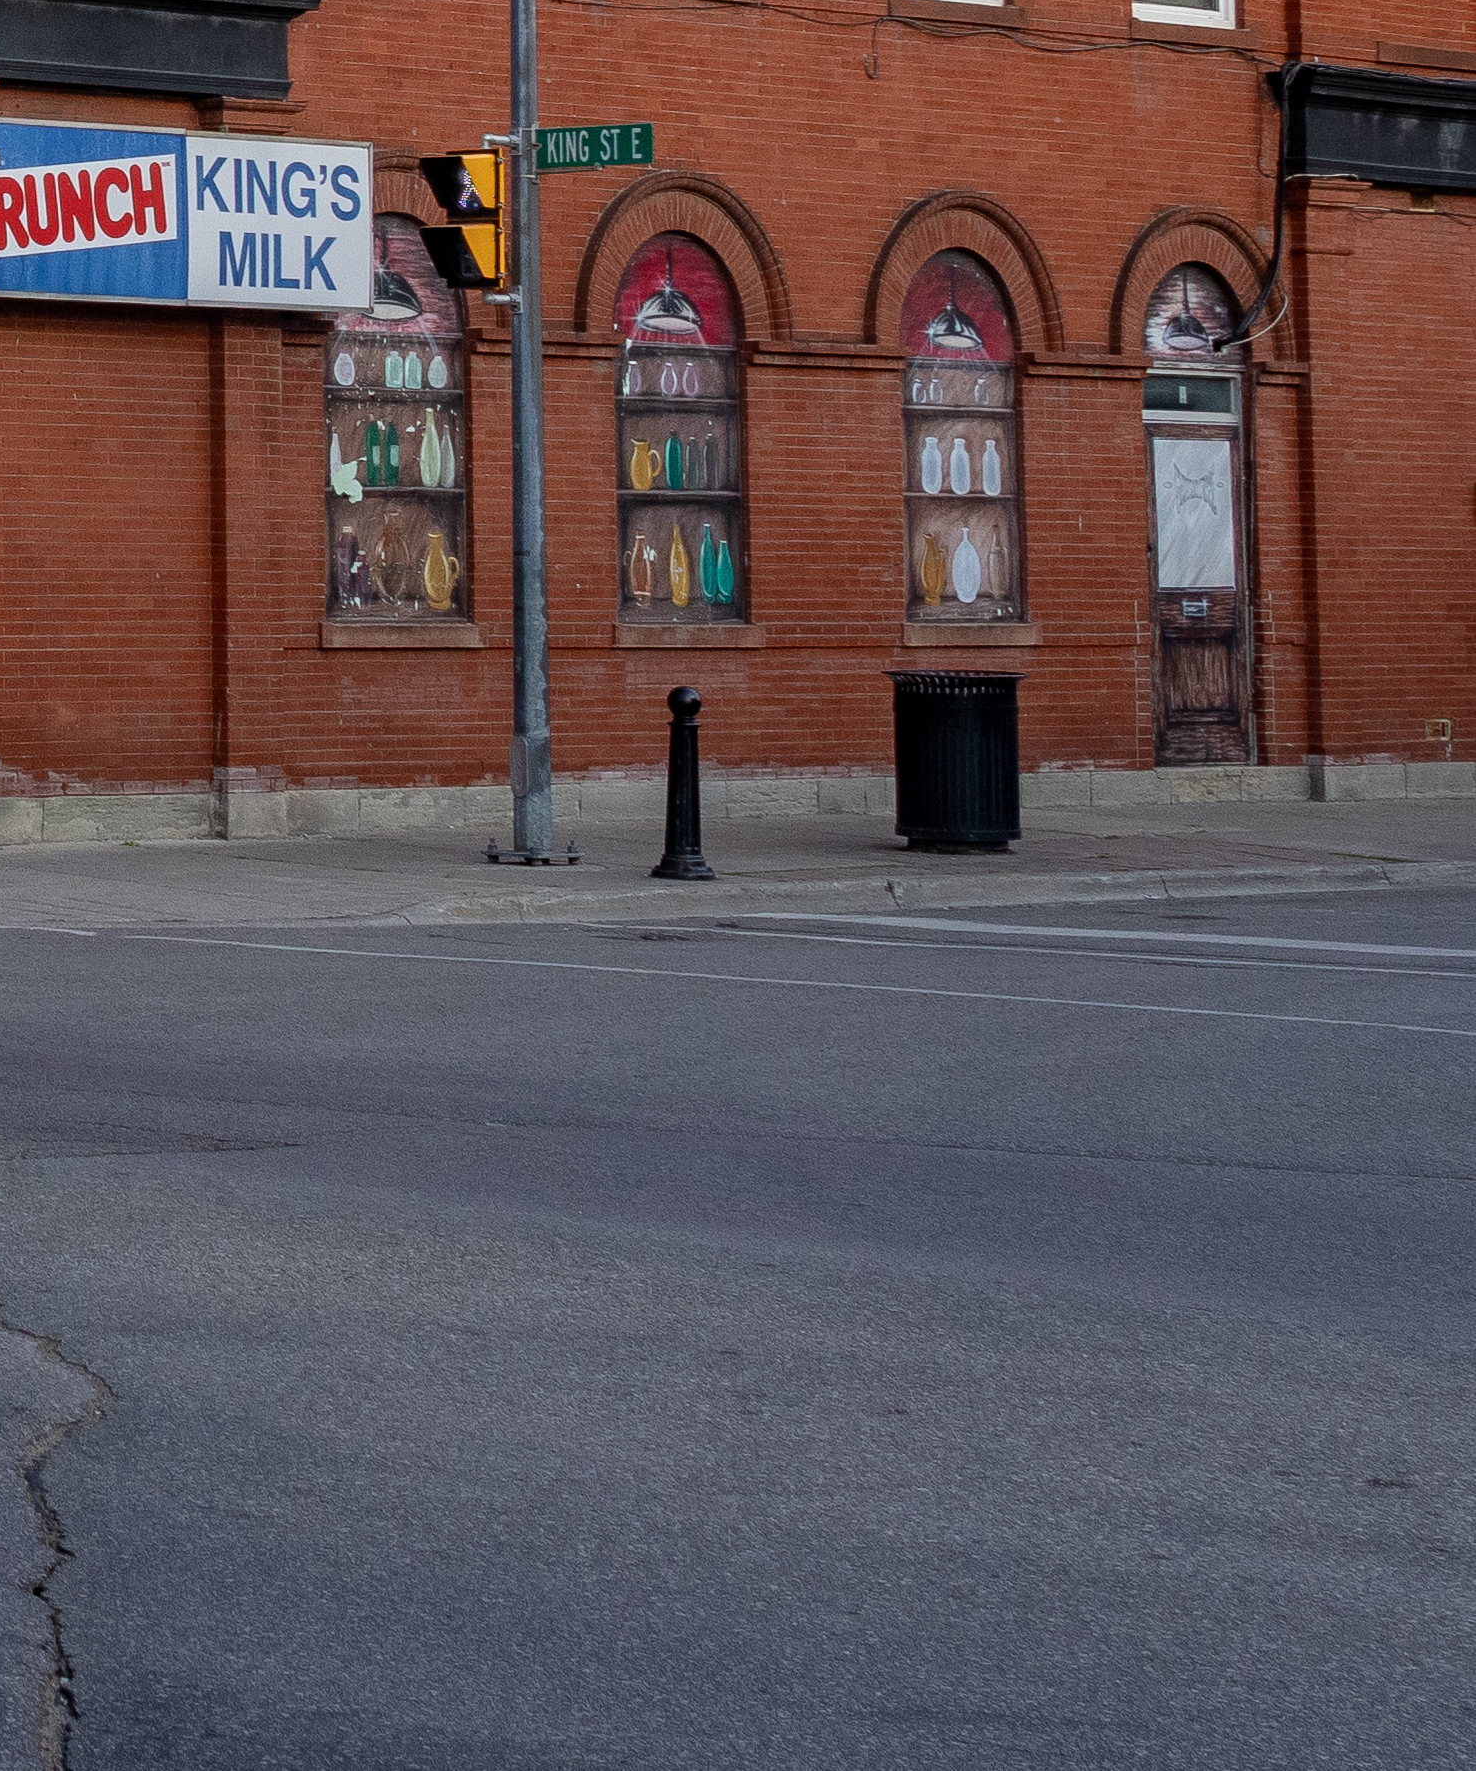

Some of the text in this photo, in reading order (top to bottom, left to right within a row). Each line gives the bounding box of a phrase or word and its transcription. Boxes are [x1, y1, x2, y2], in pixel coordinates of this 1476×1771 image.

[546, 127, 643, 164] KING ST E
[195, 154, 362, 222] KING'S
[218, 230, 338, 292] MILK
